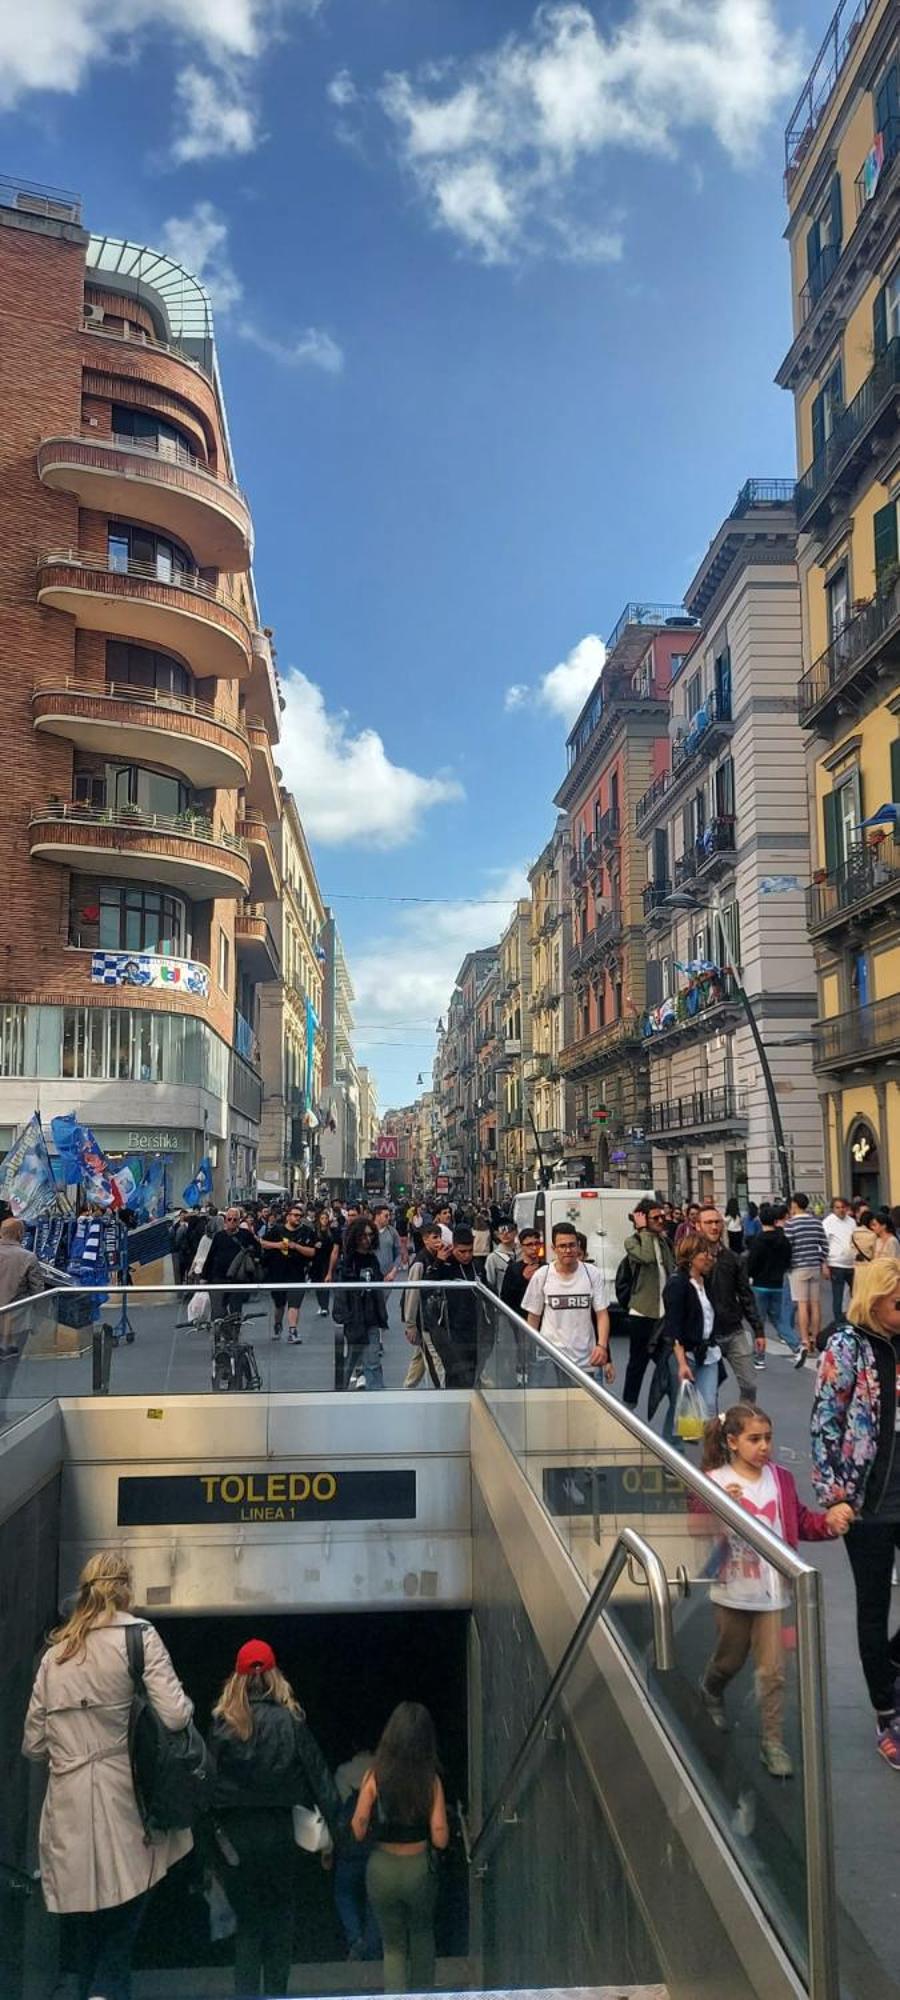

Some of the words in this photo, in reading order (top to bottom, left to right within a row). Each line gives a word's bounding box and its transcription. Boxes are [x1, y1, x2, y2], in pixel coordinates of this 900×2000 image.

[128, 1131, 178, 1149] Bershka
[380, 1141, 397, 1154] M
[551, 1296, 589, 1308] PRIS
[201, 1472, 337, 1503] TOLEDO
[241, 1507, 285, 1520] LINEA
[289, 1507, 296, 1519] 1
